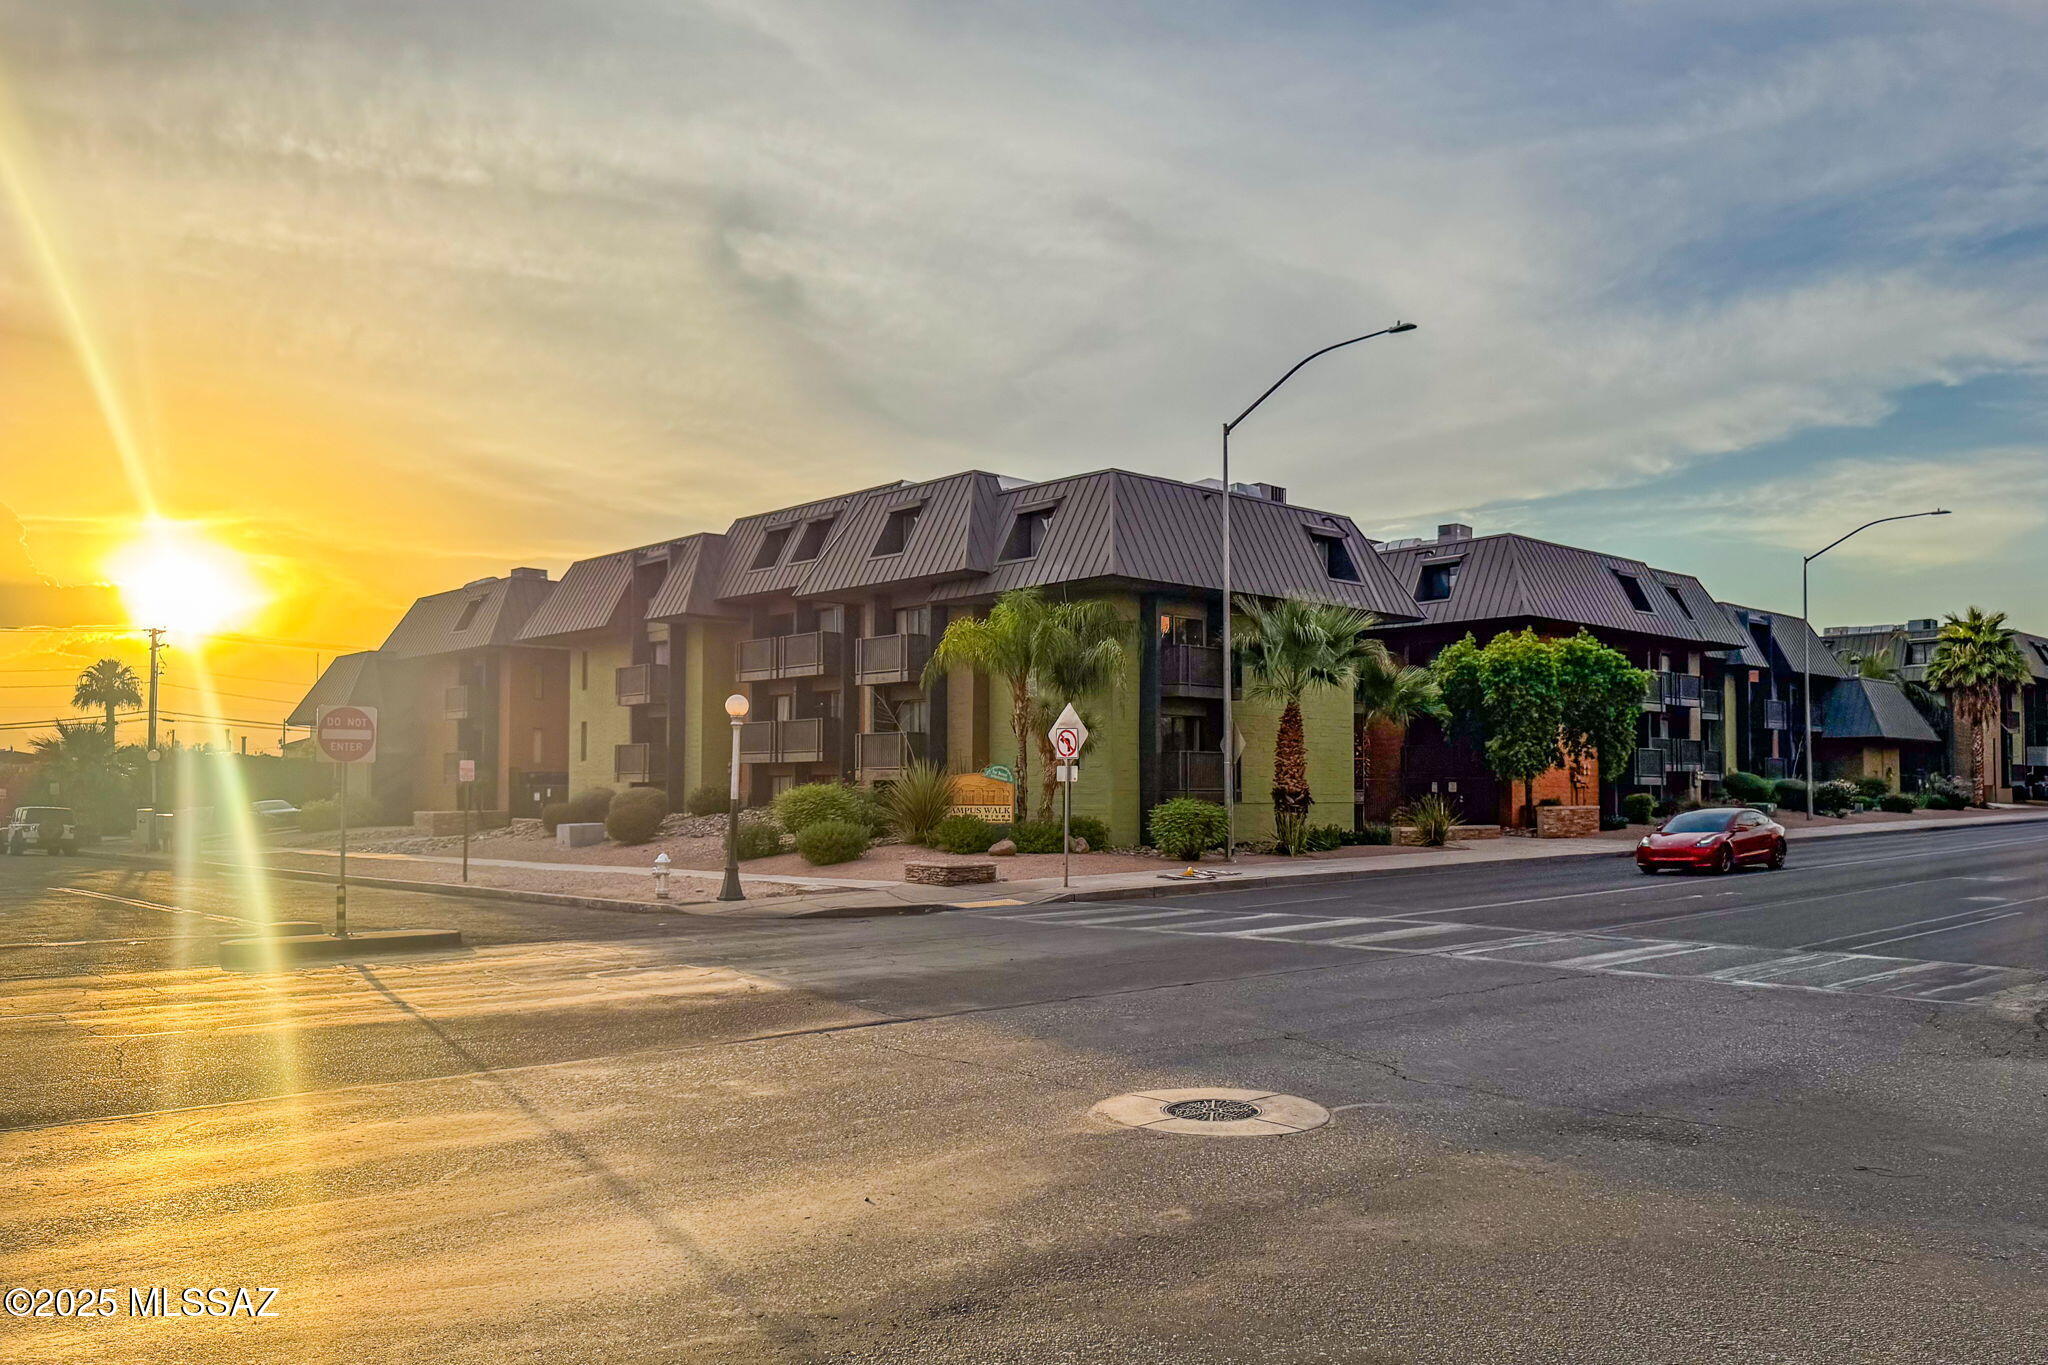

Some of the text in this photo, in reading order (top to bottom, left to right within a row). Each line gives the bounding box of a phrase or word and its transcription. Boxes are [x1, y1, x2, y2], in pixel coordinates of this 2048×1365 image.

[327, 717, 368, 727] DO NOT
[330, 742, 363, 751] ENTER
